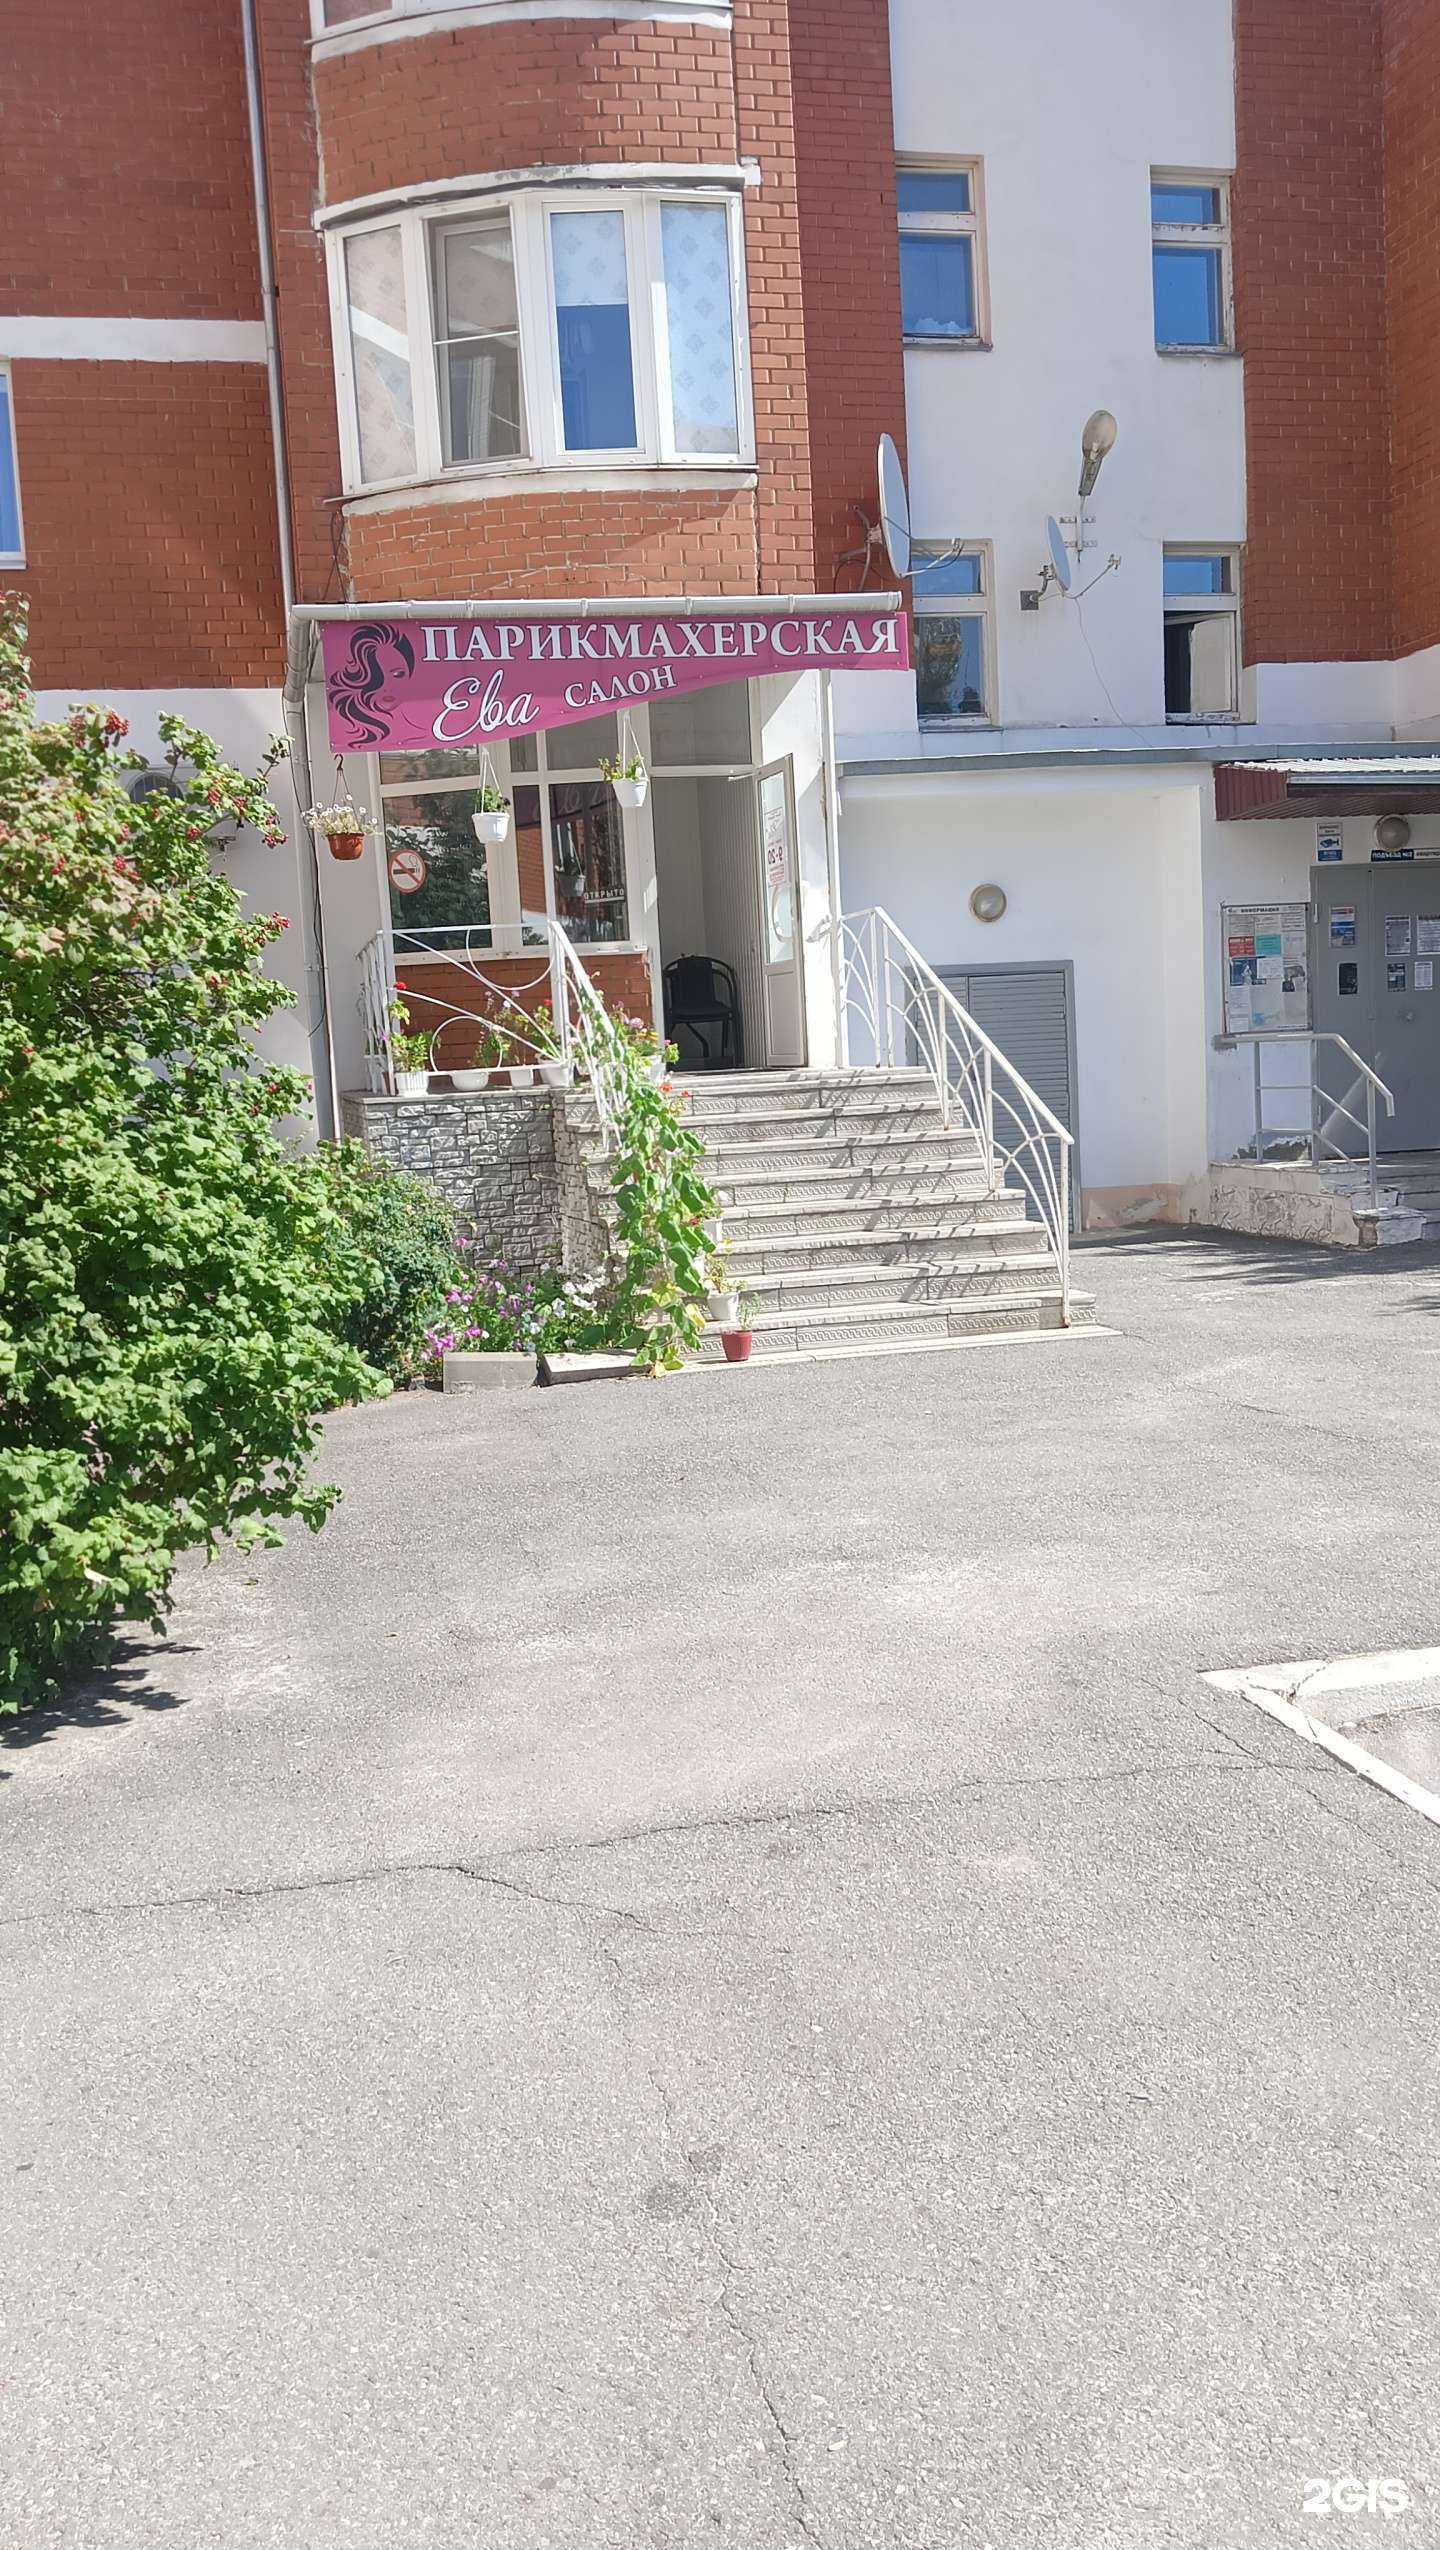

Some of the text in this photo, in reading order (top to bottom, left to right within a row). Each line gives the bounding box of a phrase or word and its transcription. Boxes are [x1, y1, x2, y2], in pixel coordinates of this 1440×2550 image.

[420, 619, 899, 661] ПАРИКМАХЕРСКАЯ
[432, 664, 677, 742] Ева САЛОН
